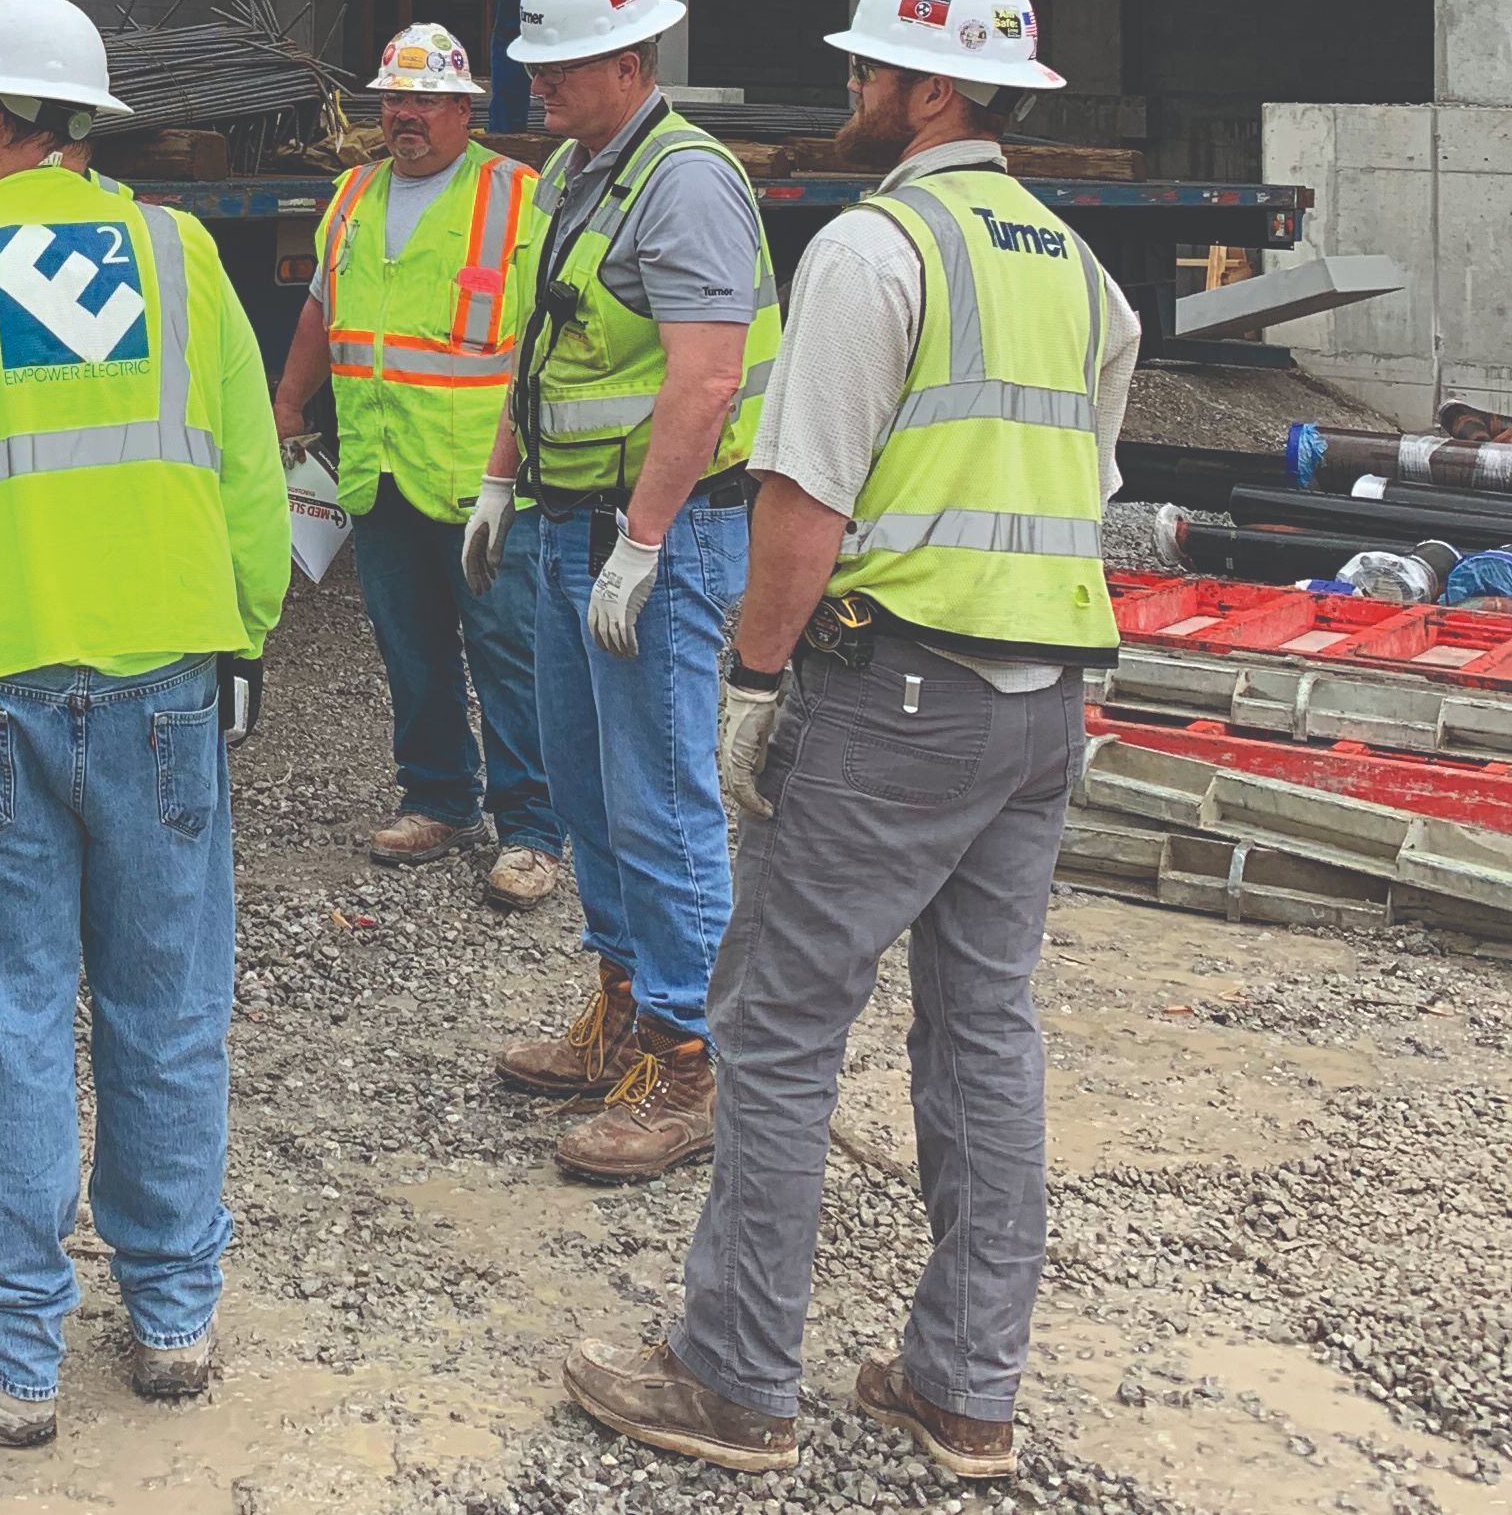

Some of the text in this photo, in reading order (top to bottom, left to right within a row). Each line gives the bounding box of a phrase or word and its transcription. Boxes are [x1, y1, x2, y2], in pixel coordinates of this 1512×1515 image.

[520, 6, 545, 25] urner
[969, 206, 1069, 260] Turner
[701, 286, 735, 297] Turner
[4, 359, 150, 386] EMPOWER ELECTRIC
[288, 500, 330, 520] MED SLE
